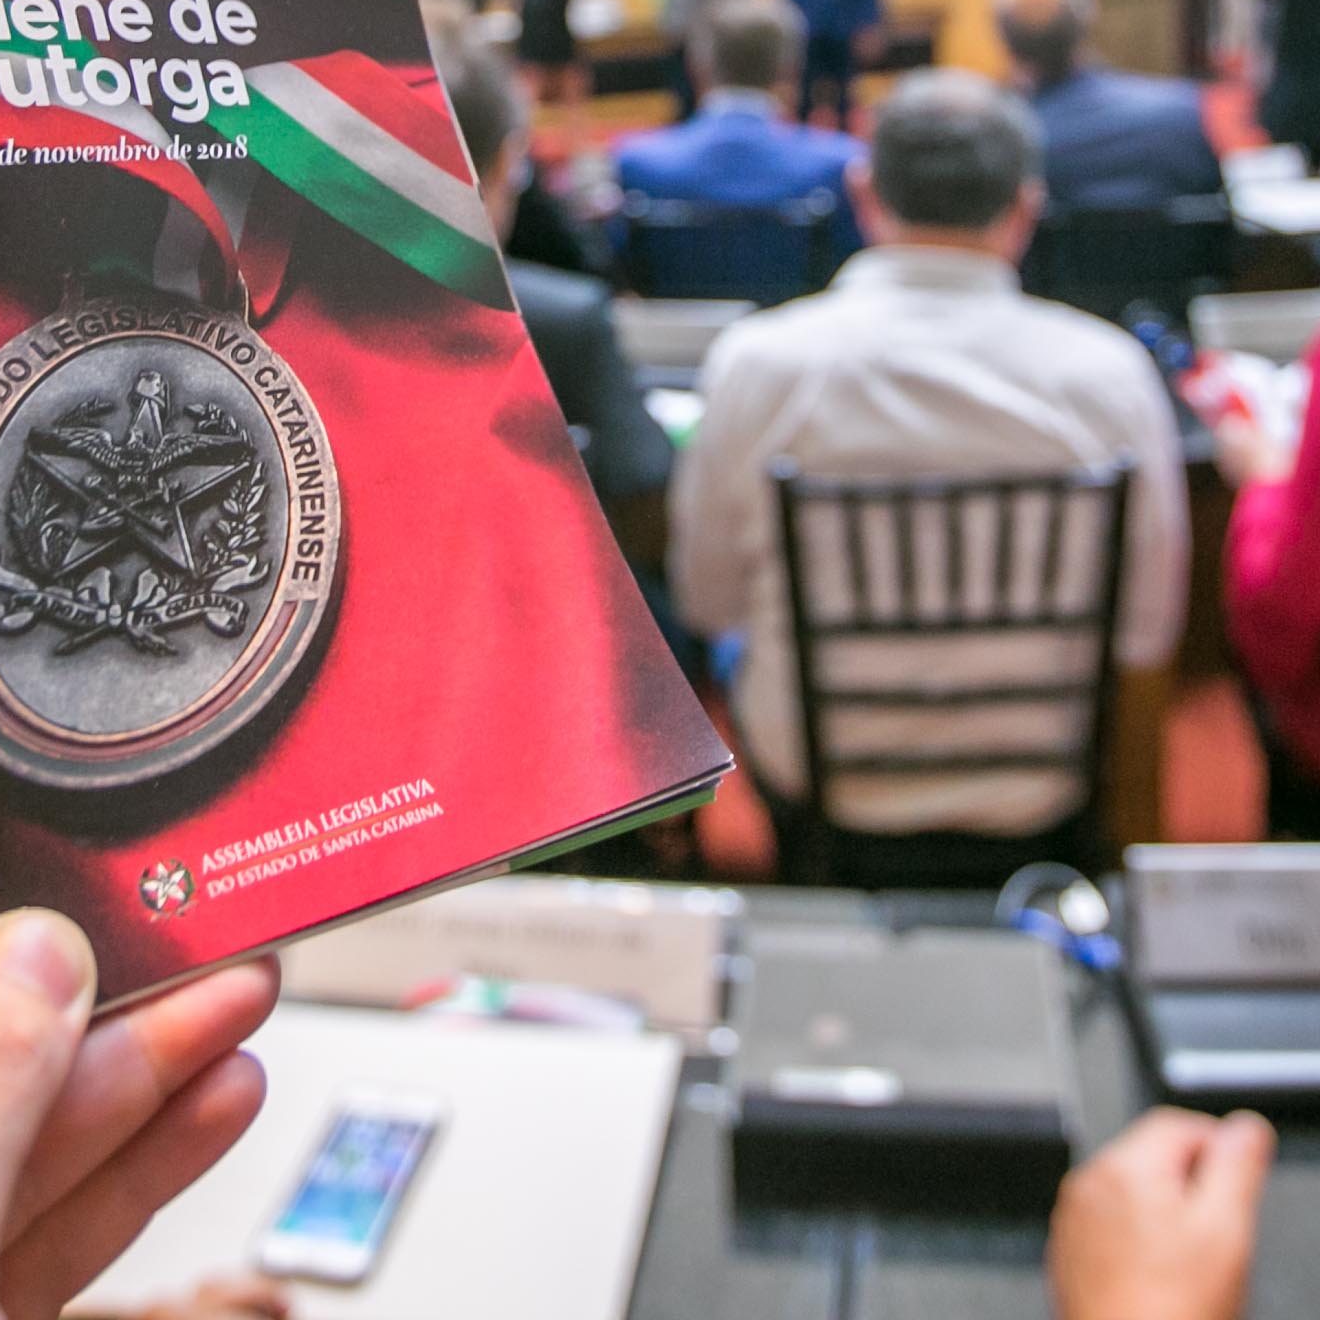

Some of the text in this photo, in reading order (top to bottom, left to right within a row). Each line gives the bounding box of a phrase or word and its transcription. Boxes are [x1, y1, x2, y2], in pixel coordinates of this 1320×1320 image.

[33, 135, 160, 165] novembro
[165, 134, 192, 161] de
[197, 133, 249, 160] 2018
[30, 306, 257, 365] LEGISLATIVO
[255, 366, 326, 582] CATARINENSE
[201, 778, 435, 874] ASSEMBLEIA LEGISLATIVA
[206, 801, 444, 898] DO ESTADO DE SANTA CATARINA
